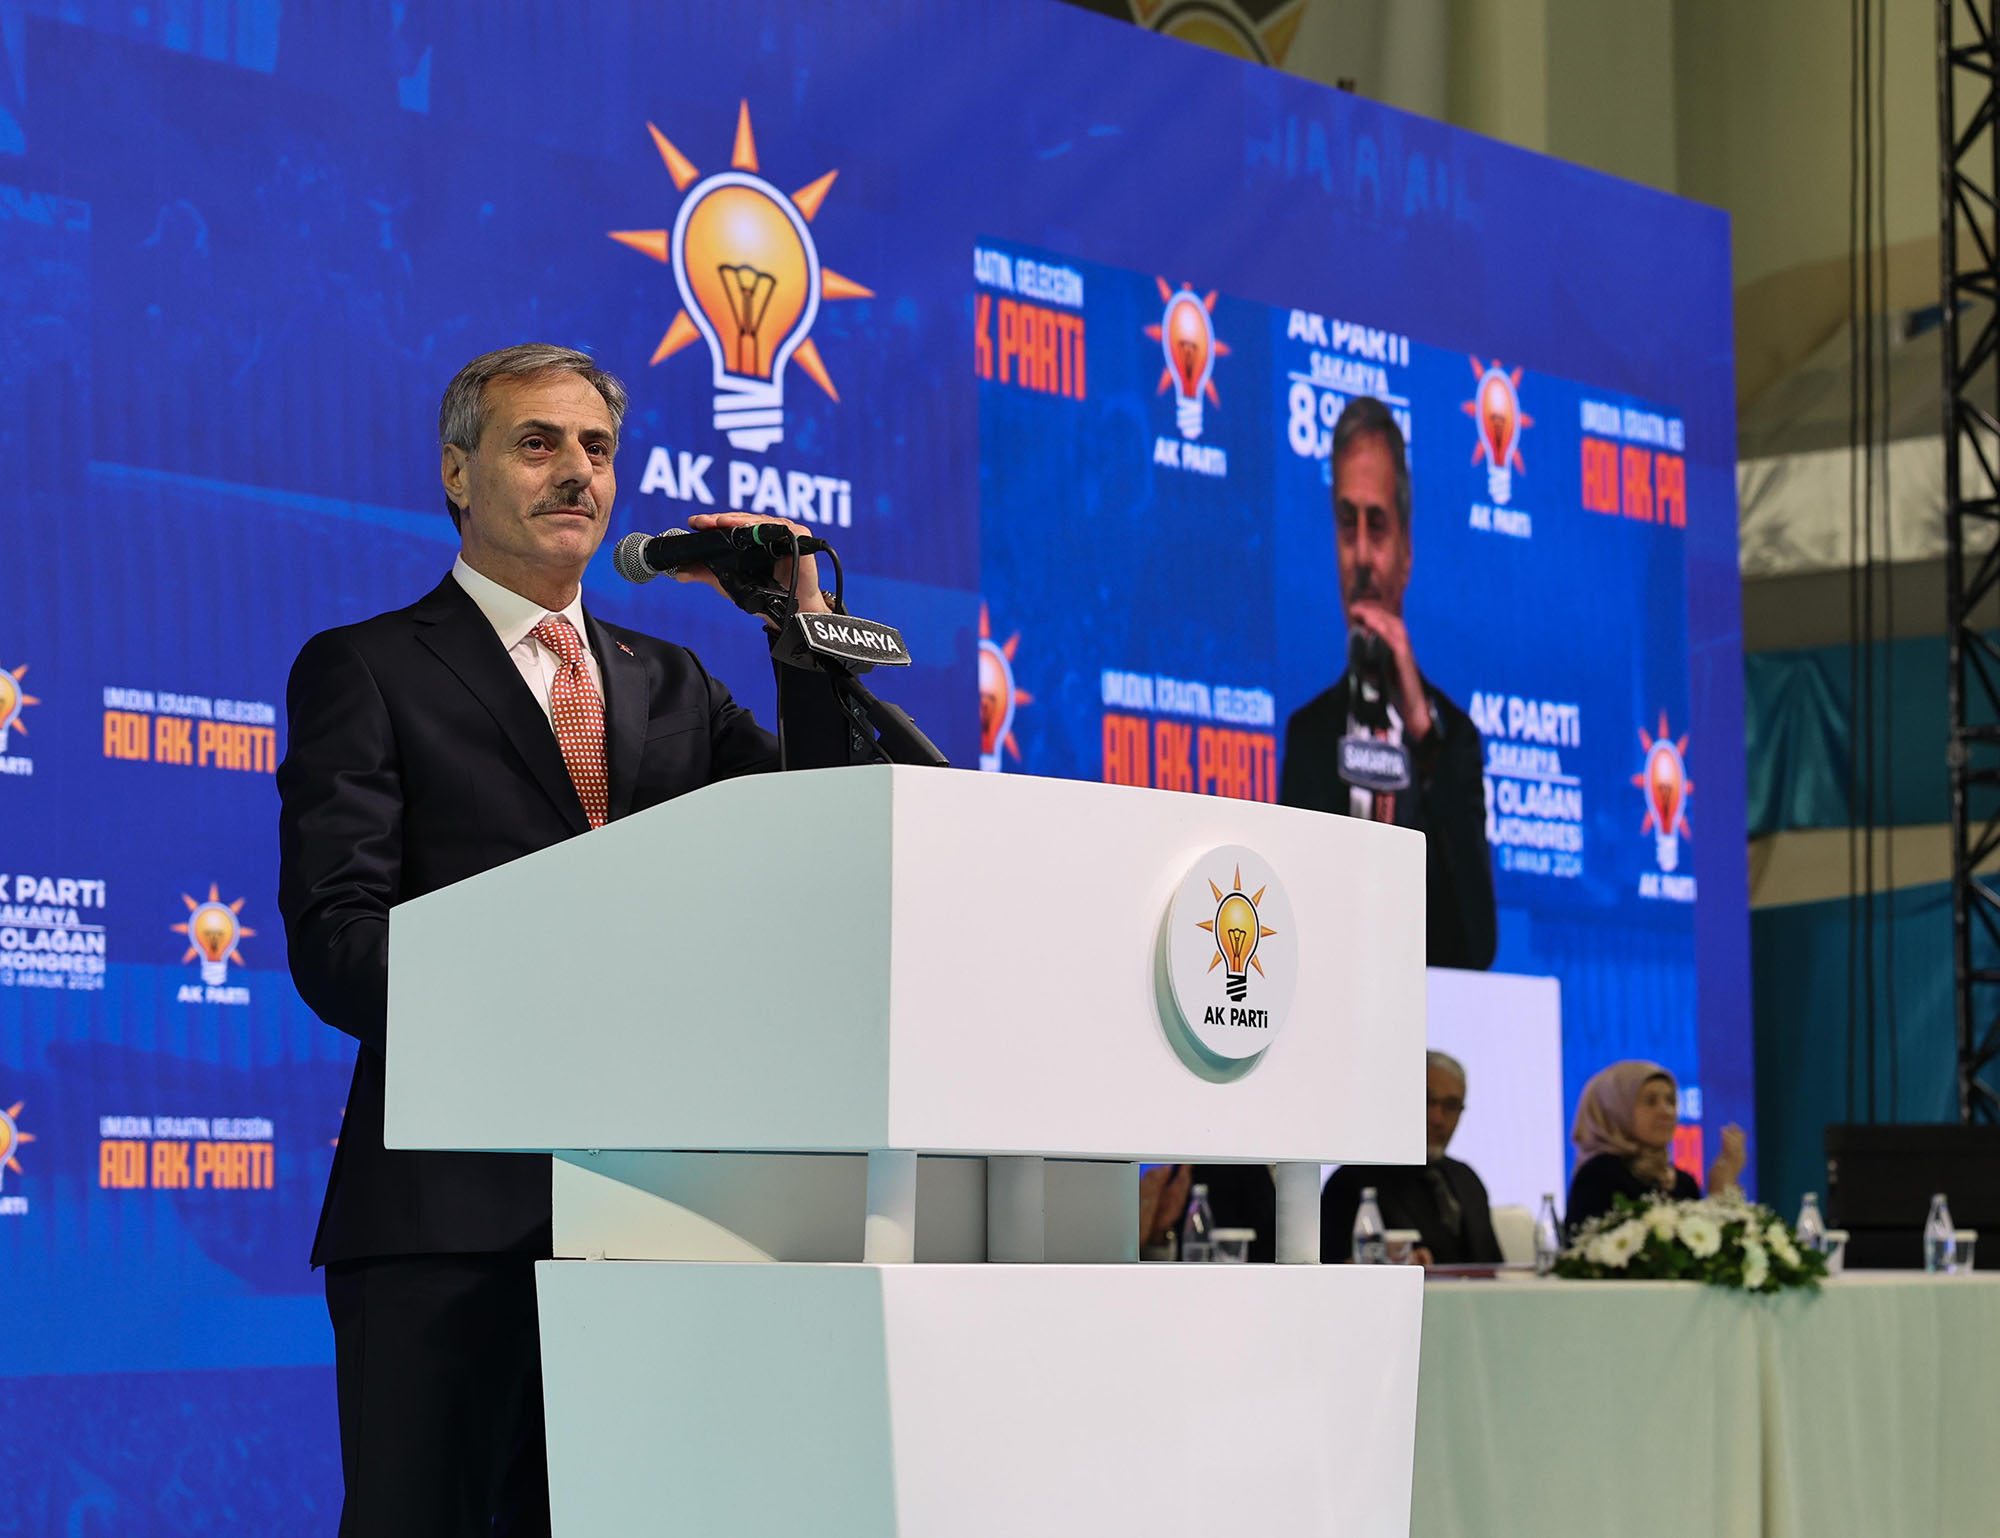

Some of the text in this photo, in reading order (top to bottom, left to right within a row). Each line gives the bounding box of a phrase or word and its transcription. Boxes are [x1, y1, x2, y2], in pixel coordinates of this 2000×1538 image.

[640, 446, 715, 505] AK
[813, 620, 902, 654] SAKARYA
[1469, 691, 1506, 738] AK
[155, 715, 193, 766] AK
[178, 984, 204, 1003] AK
[1203, 1006, 1226, 1026] AK
[152, 1140, 190, 1189] AK
